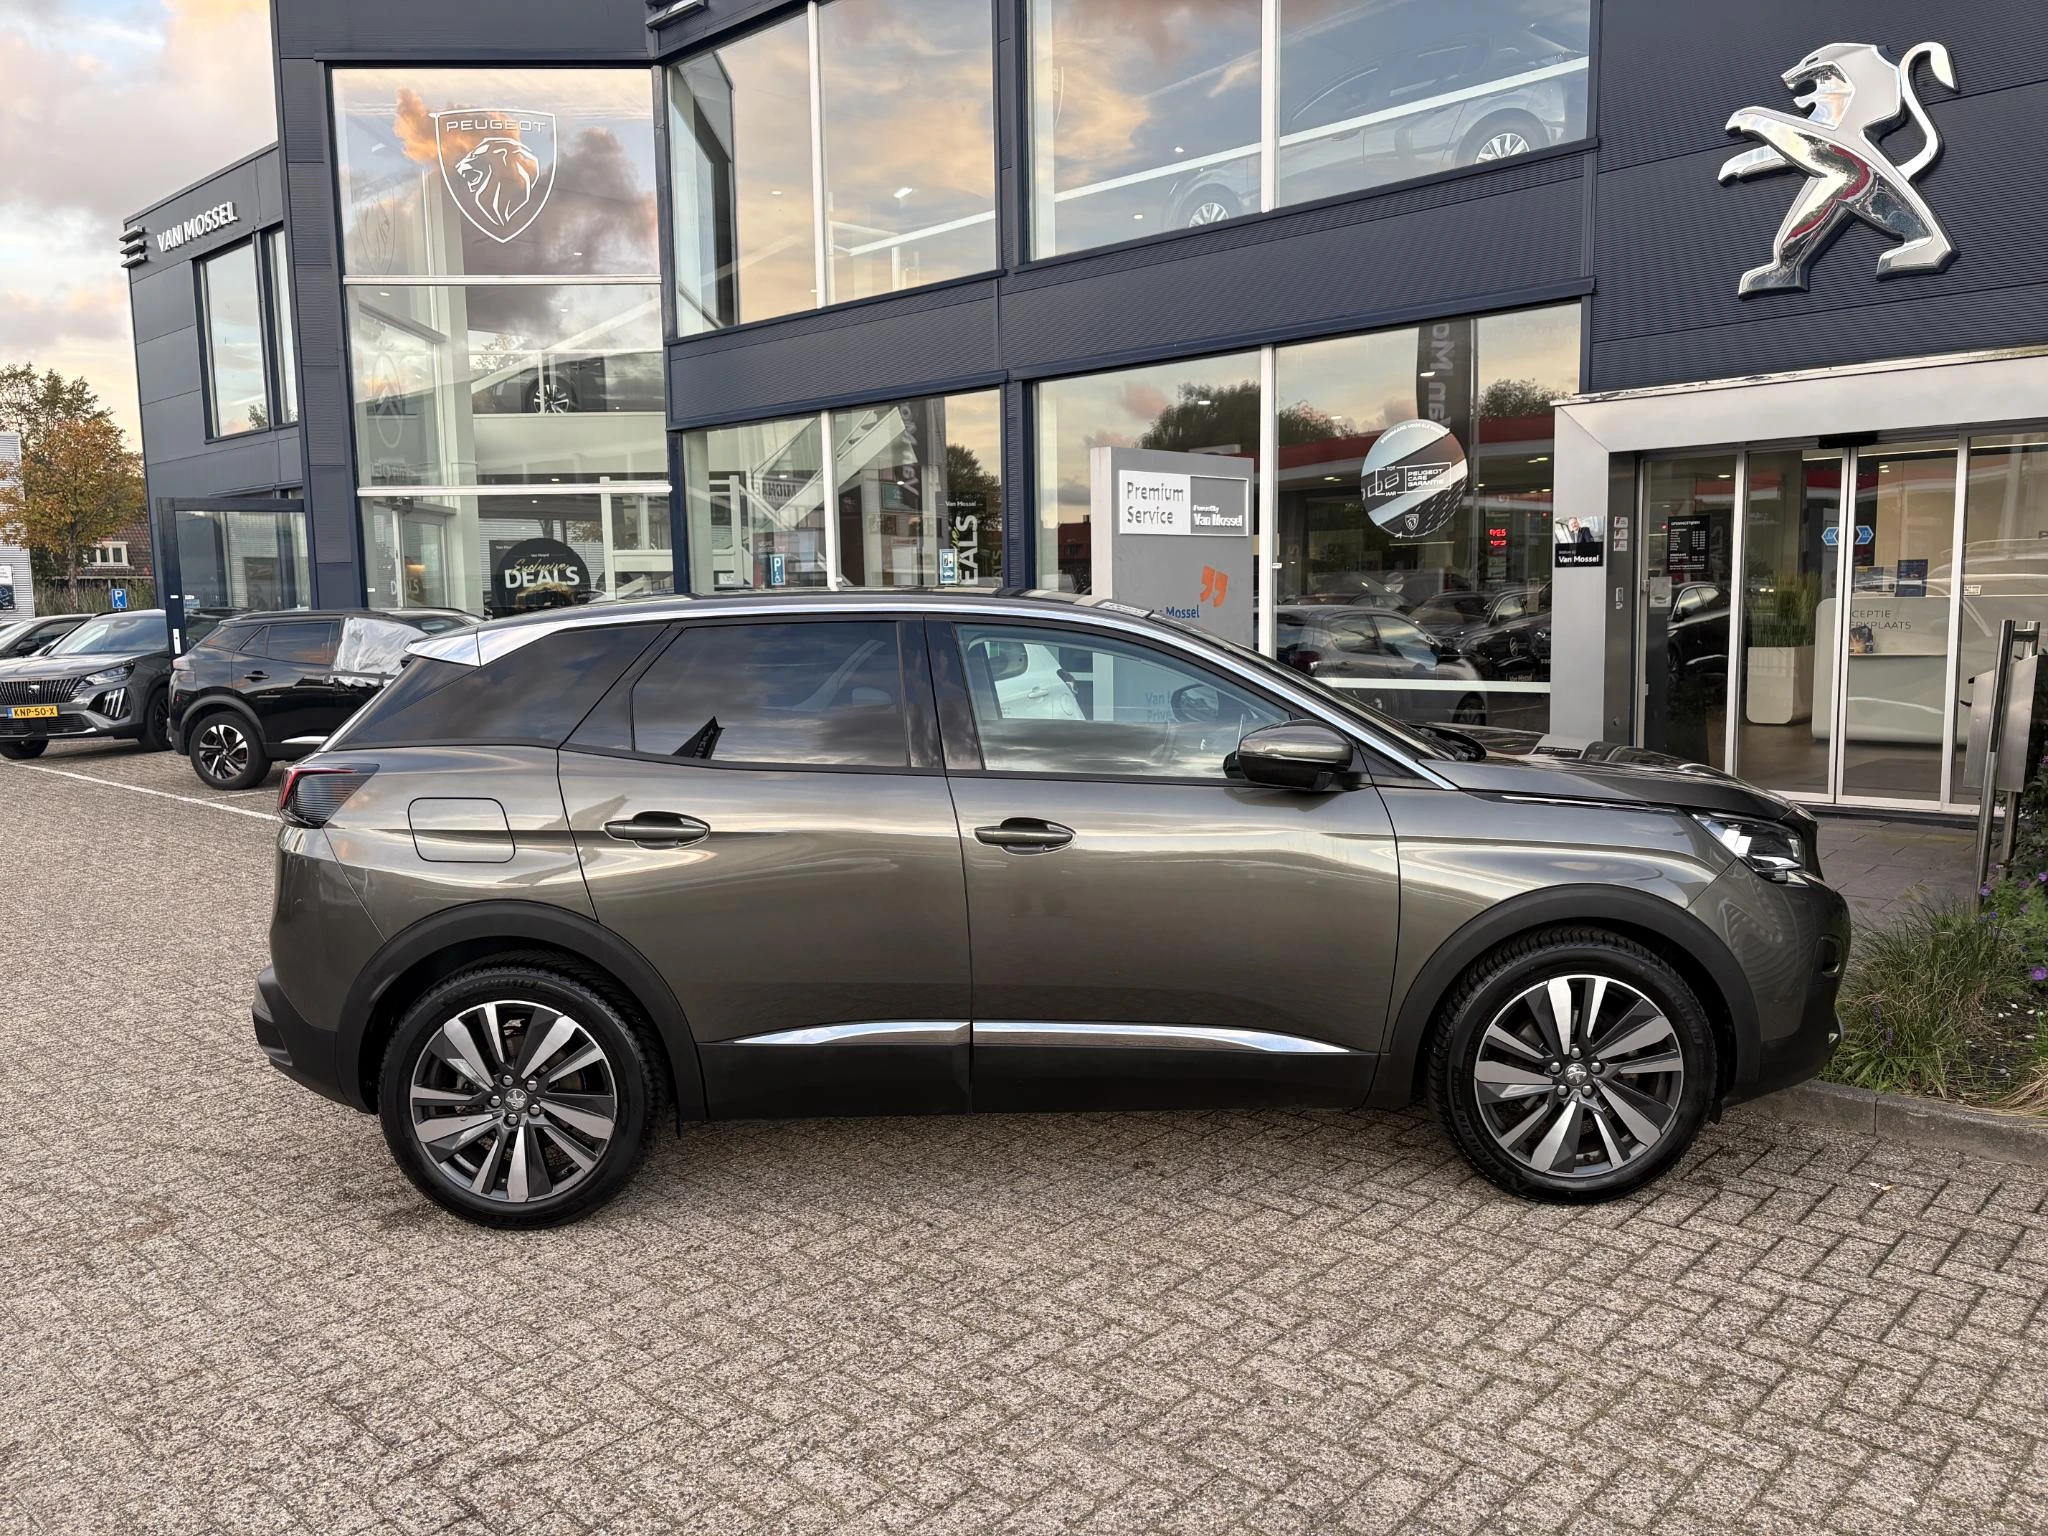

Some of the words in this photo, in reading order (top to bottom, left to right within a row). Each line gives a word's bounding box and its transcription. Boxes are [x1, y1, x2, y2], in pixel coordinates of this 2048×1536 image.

[446, 120, 546, 132] PEUGEOT
[157, 223, 184, 253] VAN
[183, 201, 238, 241] MOSSEL
[1408, 469, 1444, 477] PEUGEOT
[1126, 481, 1184, 501] Premium
[1127, 506, 1174, 525] Service
[1193, 513, 1211, 526] Van
[1212, 513, 1243, 526] Mossel
[774, 557, 781, 571] P
[1573, 555, 1599, 563] Mossel
[504, 566, 580, 589] DEALS
[115, 590, 123, 601] P
[1166, 604, 1200, 619] Mossel
[14, 707, 55, 717] KNP-50-X
